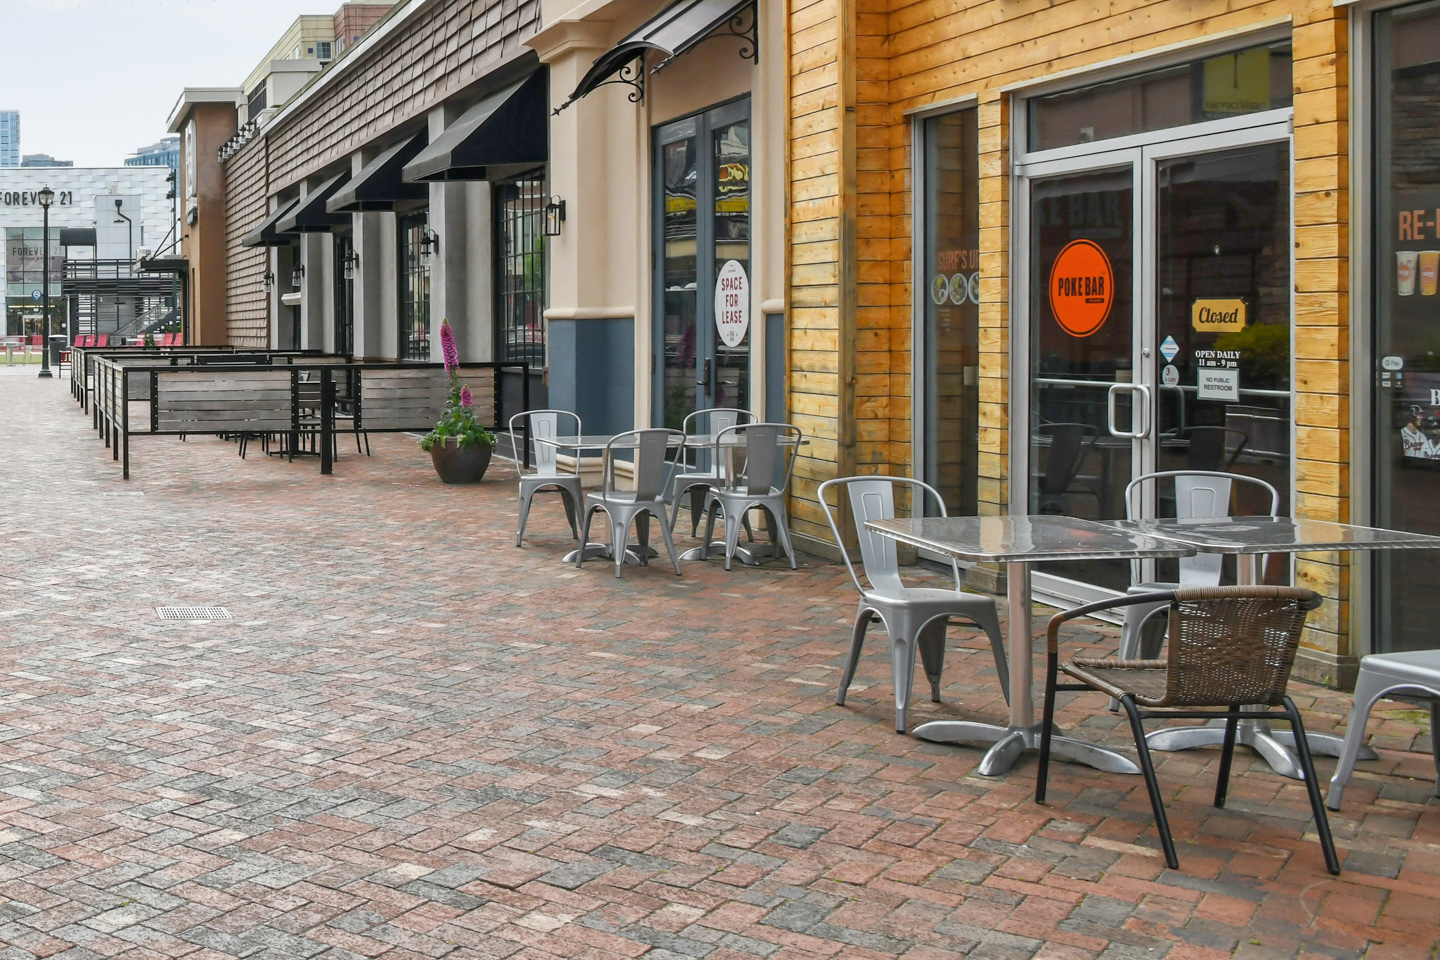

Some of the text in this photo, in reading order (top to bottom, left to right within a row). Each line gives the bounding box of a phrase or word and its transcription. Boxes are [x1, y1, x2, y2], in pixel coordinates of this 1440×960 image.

[60, 191, 73, 206] 21
[12, 247, 48, 256] FOREVE
[721, 276, 743, 292] SPACE
[1085, 276, 1105, 296] BAR
[725, 294, 739, 308] FOR
[721, 310, 743, 325] LEASE
[1198, 306, 1239, 324] Closed
[1195, 350, 1241, 359] OPEN DAILY
[1227, 360, 1238, 368] pm
